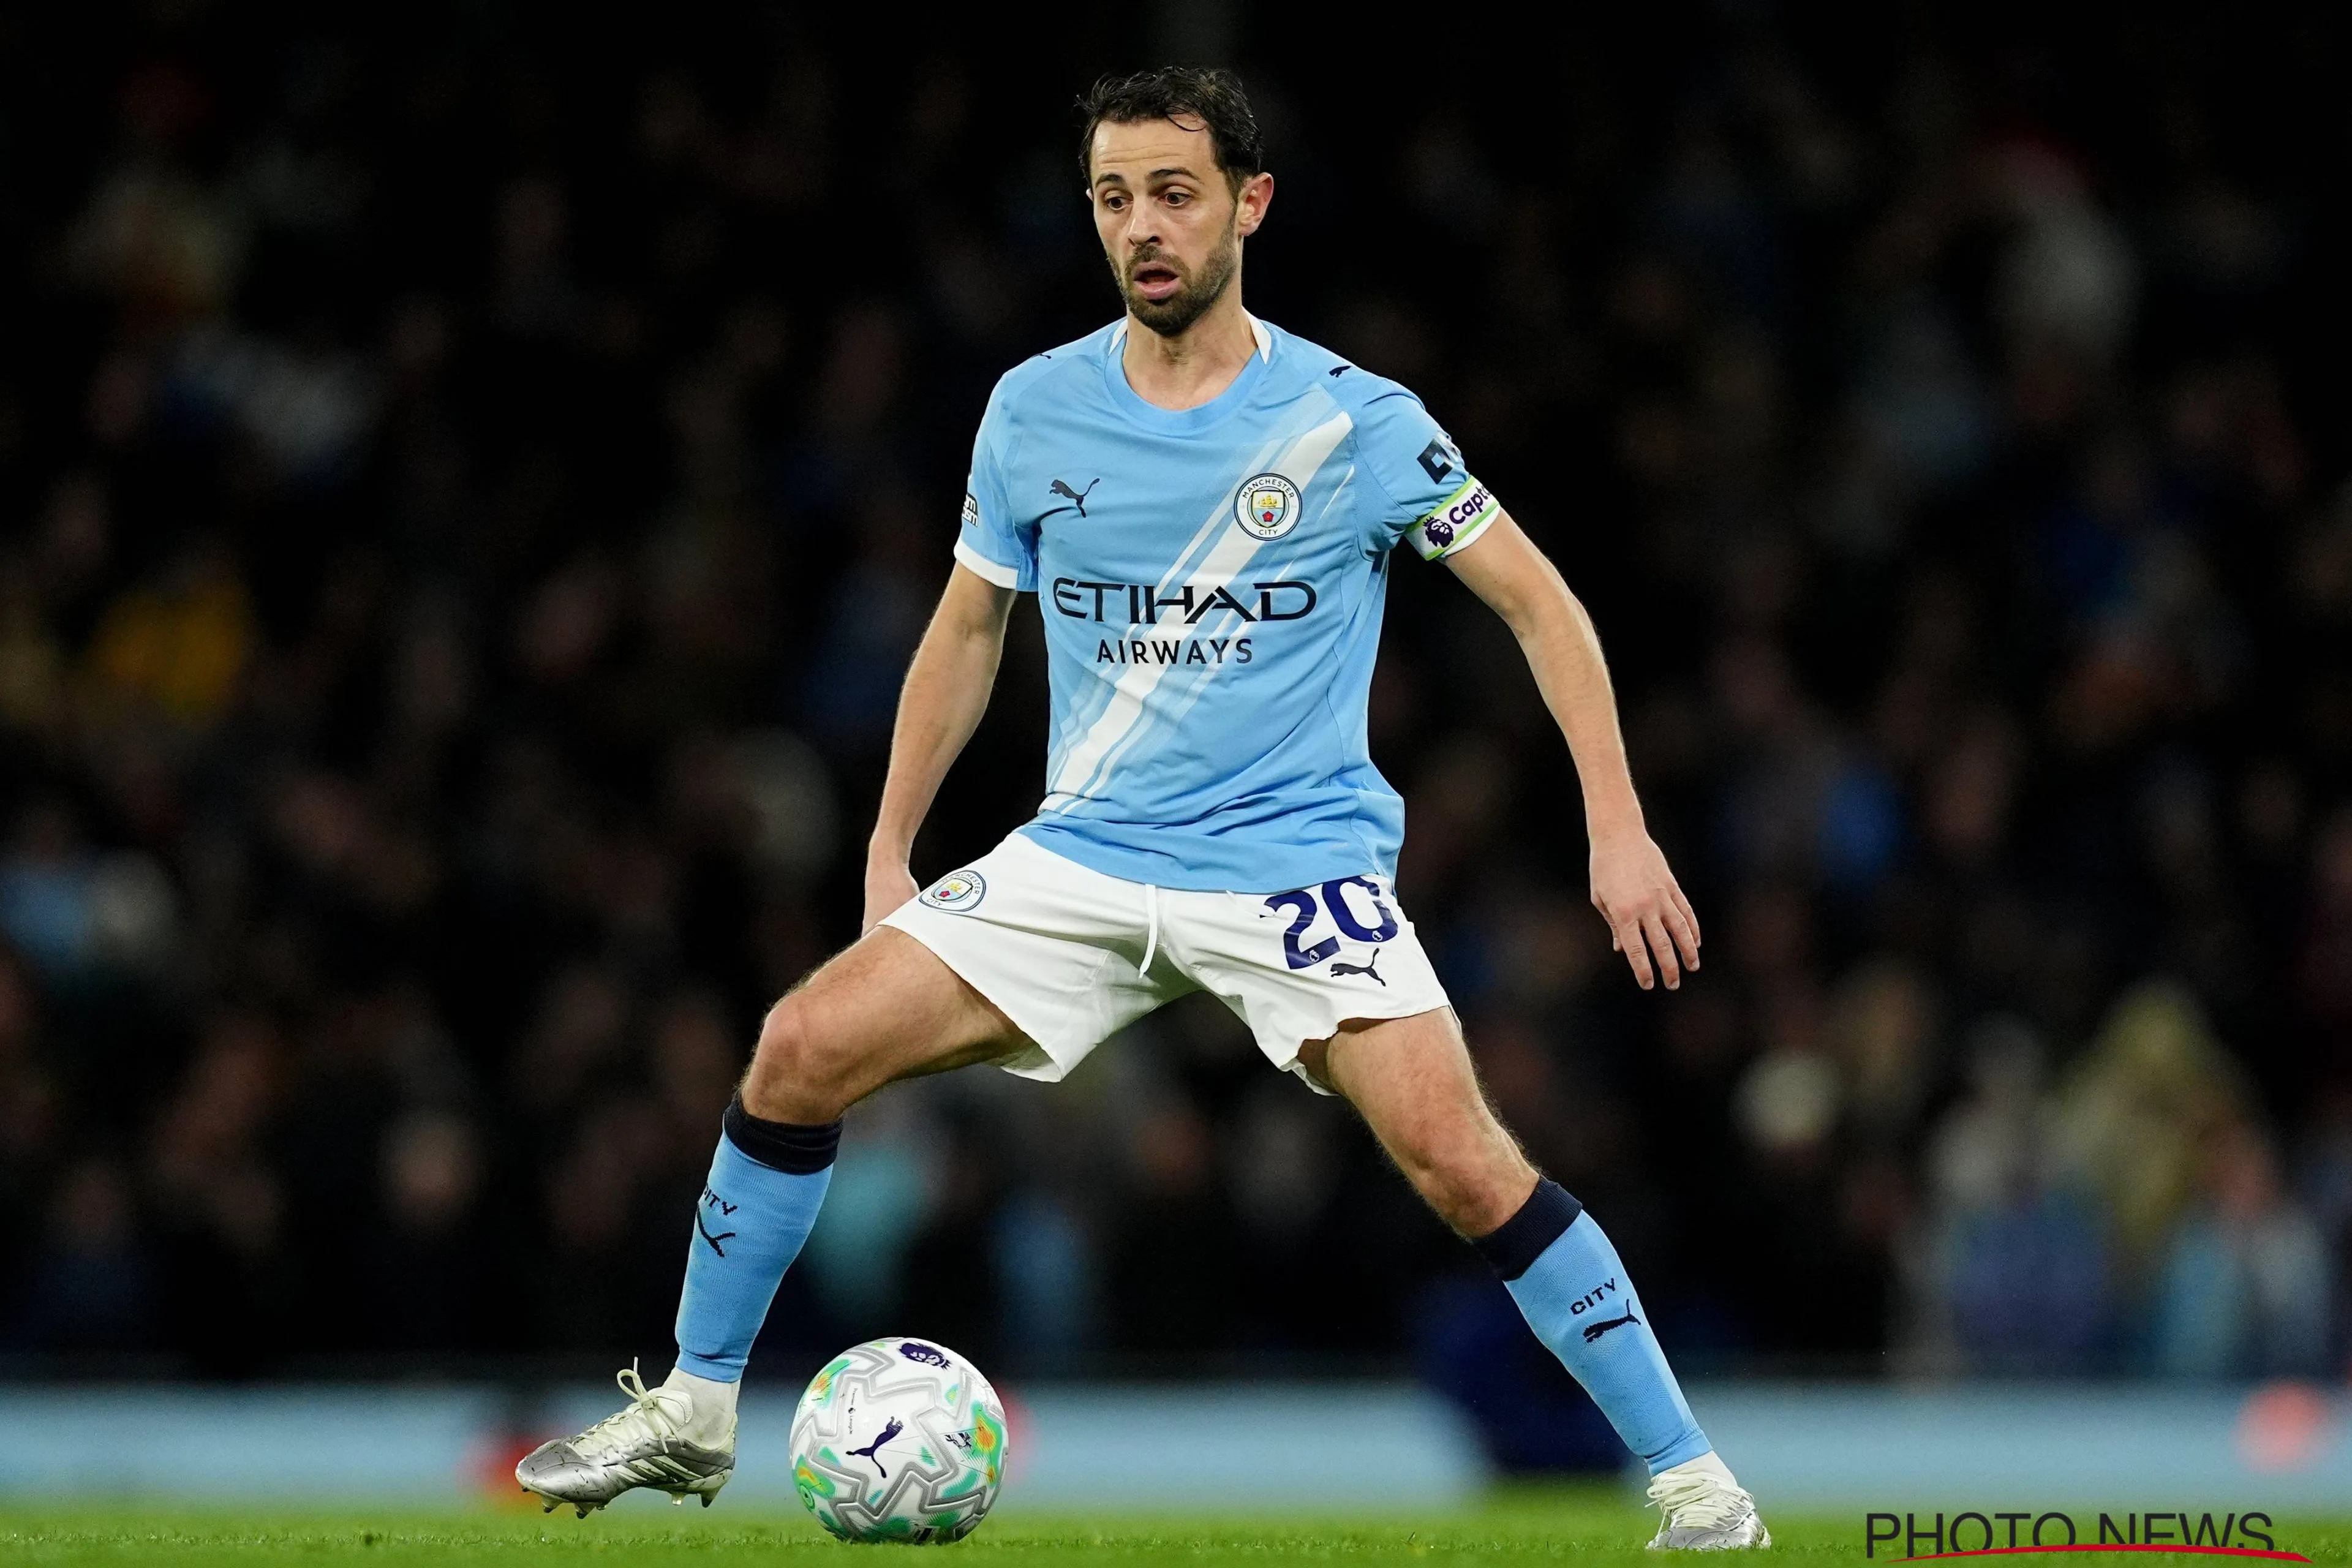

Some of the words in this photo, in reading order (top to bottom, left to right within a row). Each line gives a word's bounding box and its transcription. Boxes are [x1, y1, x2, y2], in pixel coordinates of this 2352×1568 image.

[1242, 478, 1294, 499] MANCHESTER
[1449, 486, 1491, 524] Capt
[1053, 577, 1317, 625] ETIHAD
[1097, 638, 1253, 665] AIRWAYS
[1264, 875, 1398, 969] 20
[1570, 1278, 1615, 1315] CITY
